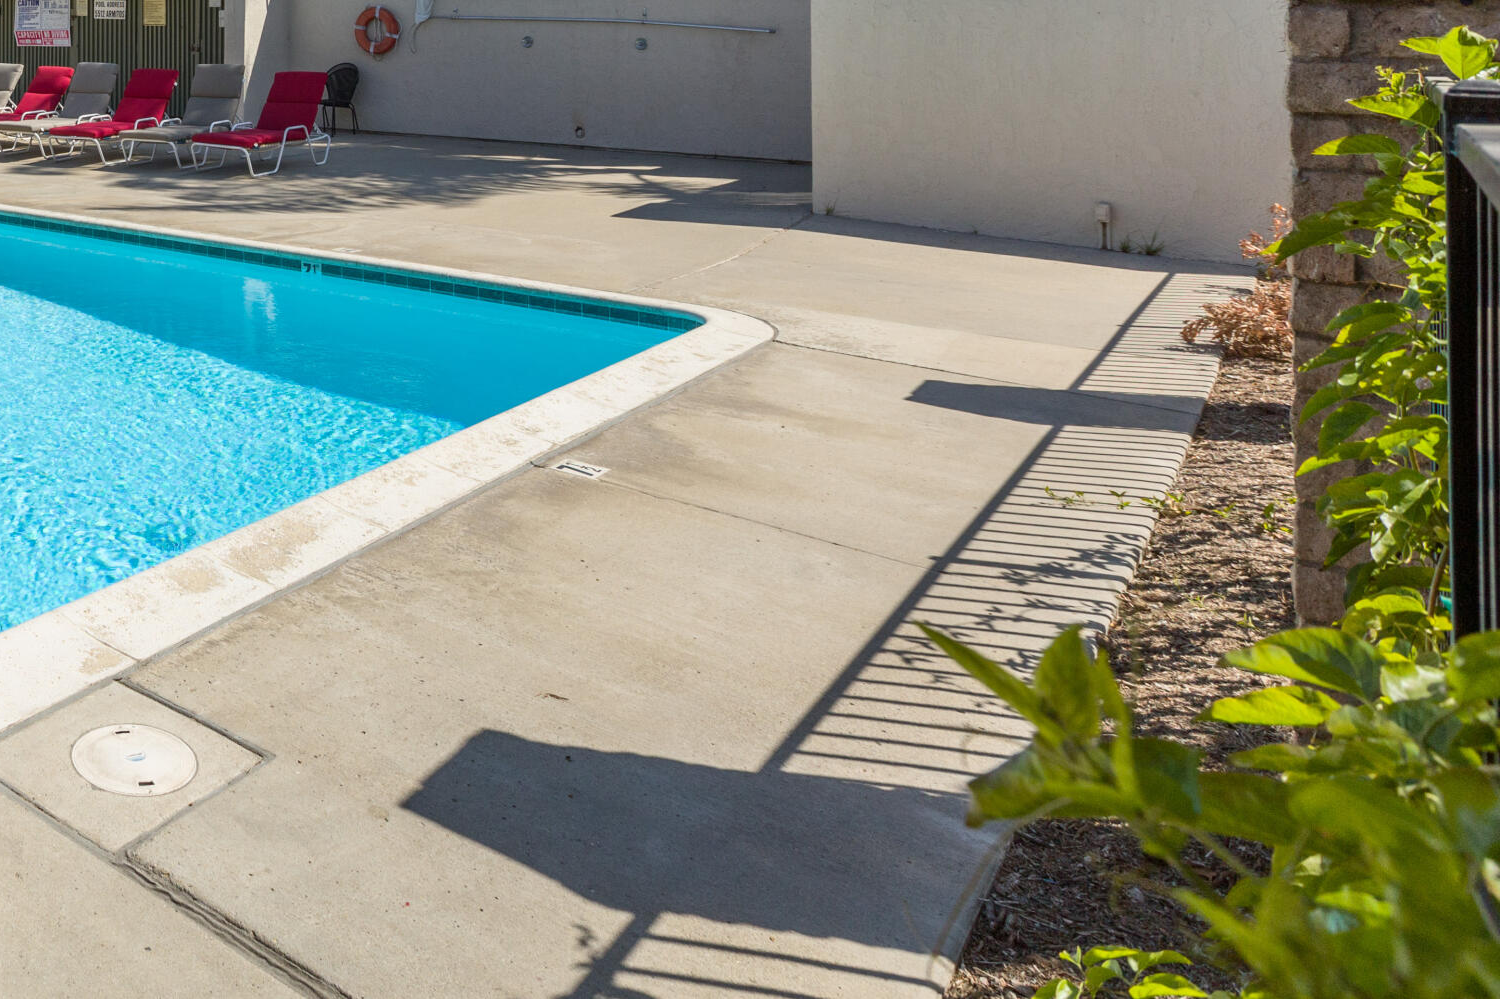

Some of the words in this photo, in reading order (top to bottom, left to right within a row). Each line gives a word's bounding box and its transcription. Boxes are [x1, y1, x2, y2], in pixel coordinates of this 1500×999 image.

[17, 0, 40, 7] CAUTION
[16, 31, 42, 39] CAPACITY
[43, 30, 51, 39] NO
[51, 30, 69, 38] DIVING
